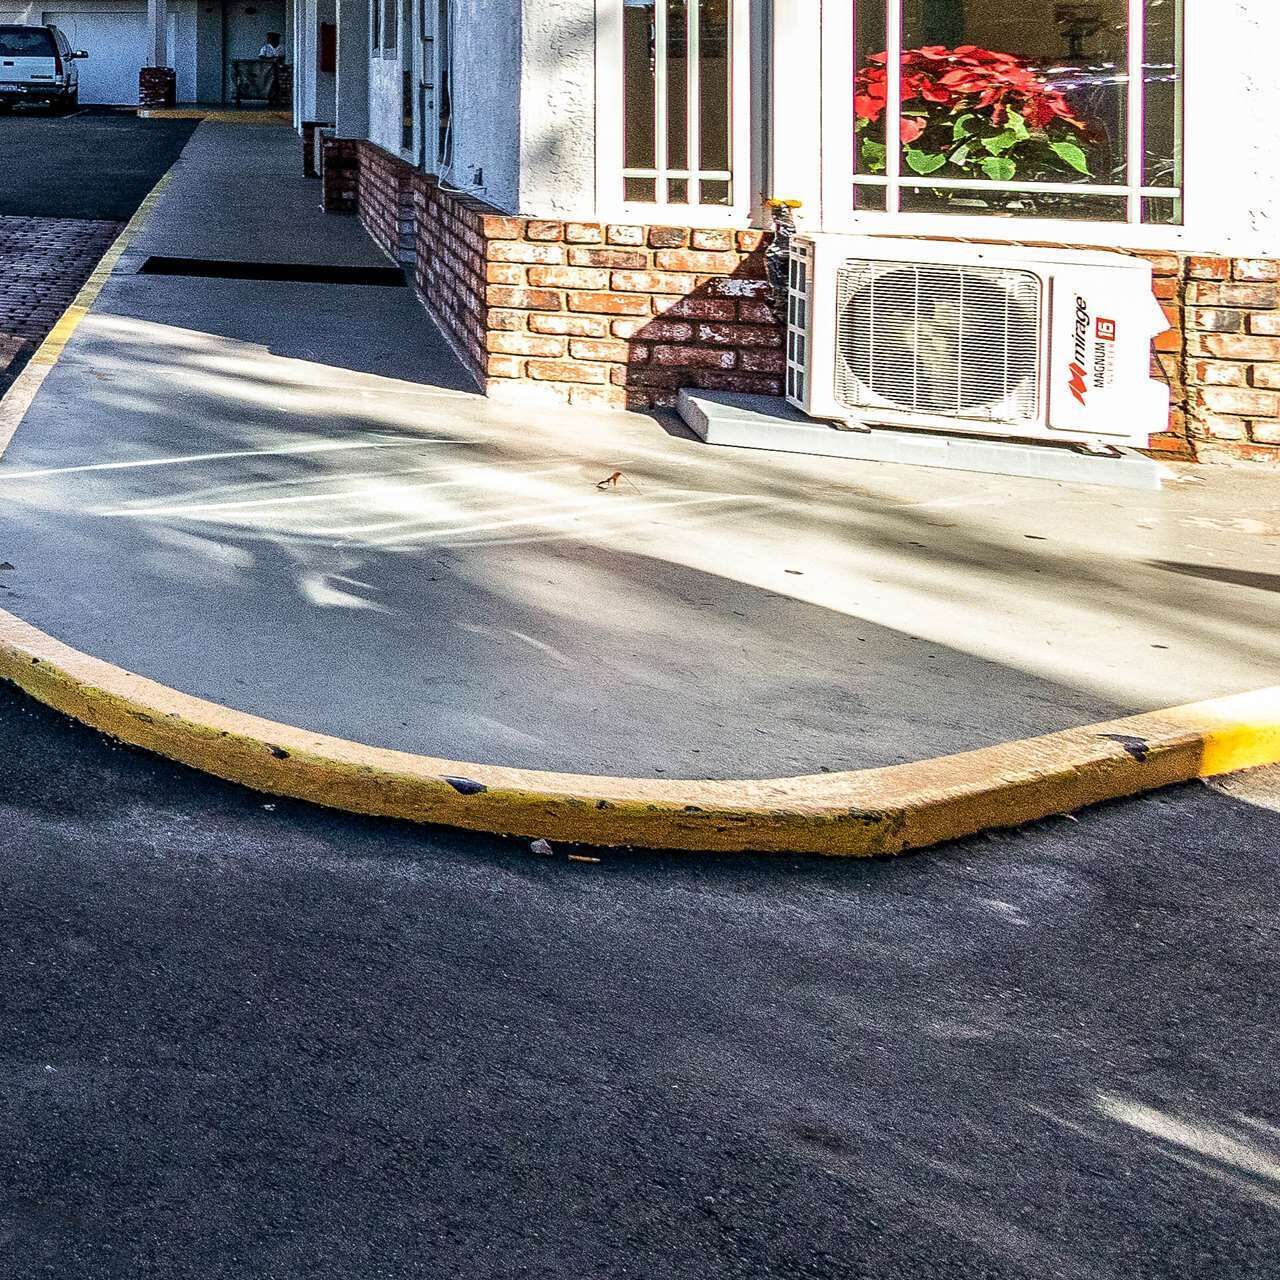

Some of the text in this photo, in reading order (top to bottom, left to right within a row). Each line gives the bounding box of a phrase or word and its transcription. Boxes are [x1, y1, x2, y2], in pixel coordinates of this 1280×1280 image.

[1071, 296, 1090, 366] mirage
[1097, 320, 1114, 338] 16
[1093, 342, 1106, 388] MAGNUM
